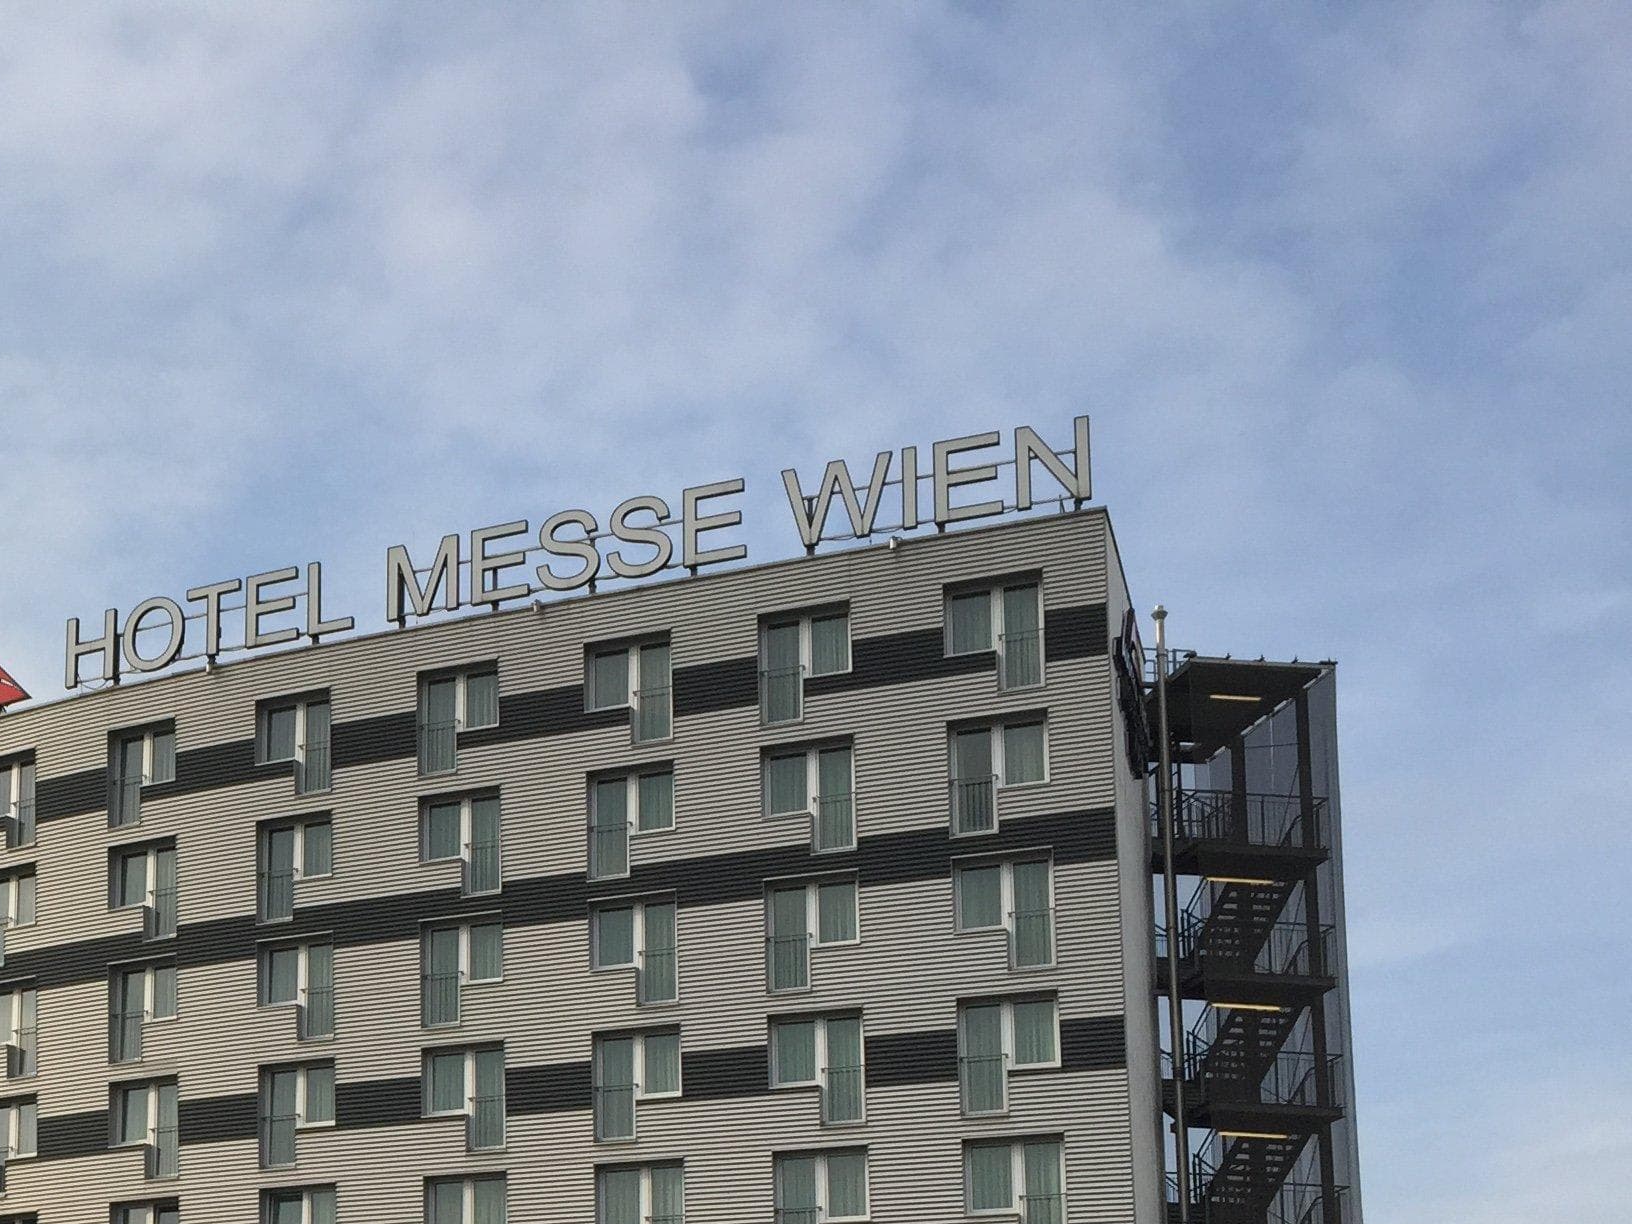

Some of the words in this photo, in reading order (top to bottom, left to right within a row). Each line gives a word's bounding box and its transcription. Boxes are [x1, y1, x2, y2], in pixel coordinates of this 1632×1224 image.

[65, 561, 355, 689] HOTEL
[386, 477, 747, 622] MESSE
[781, 415, 1092, 547] WIEN
